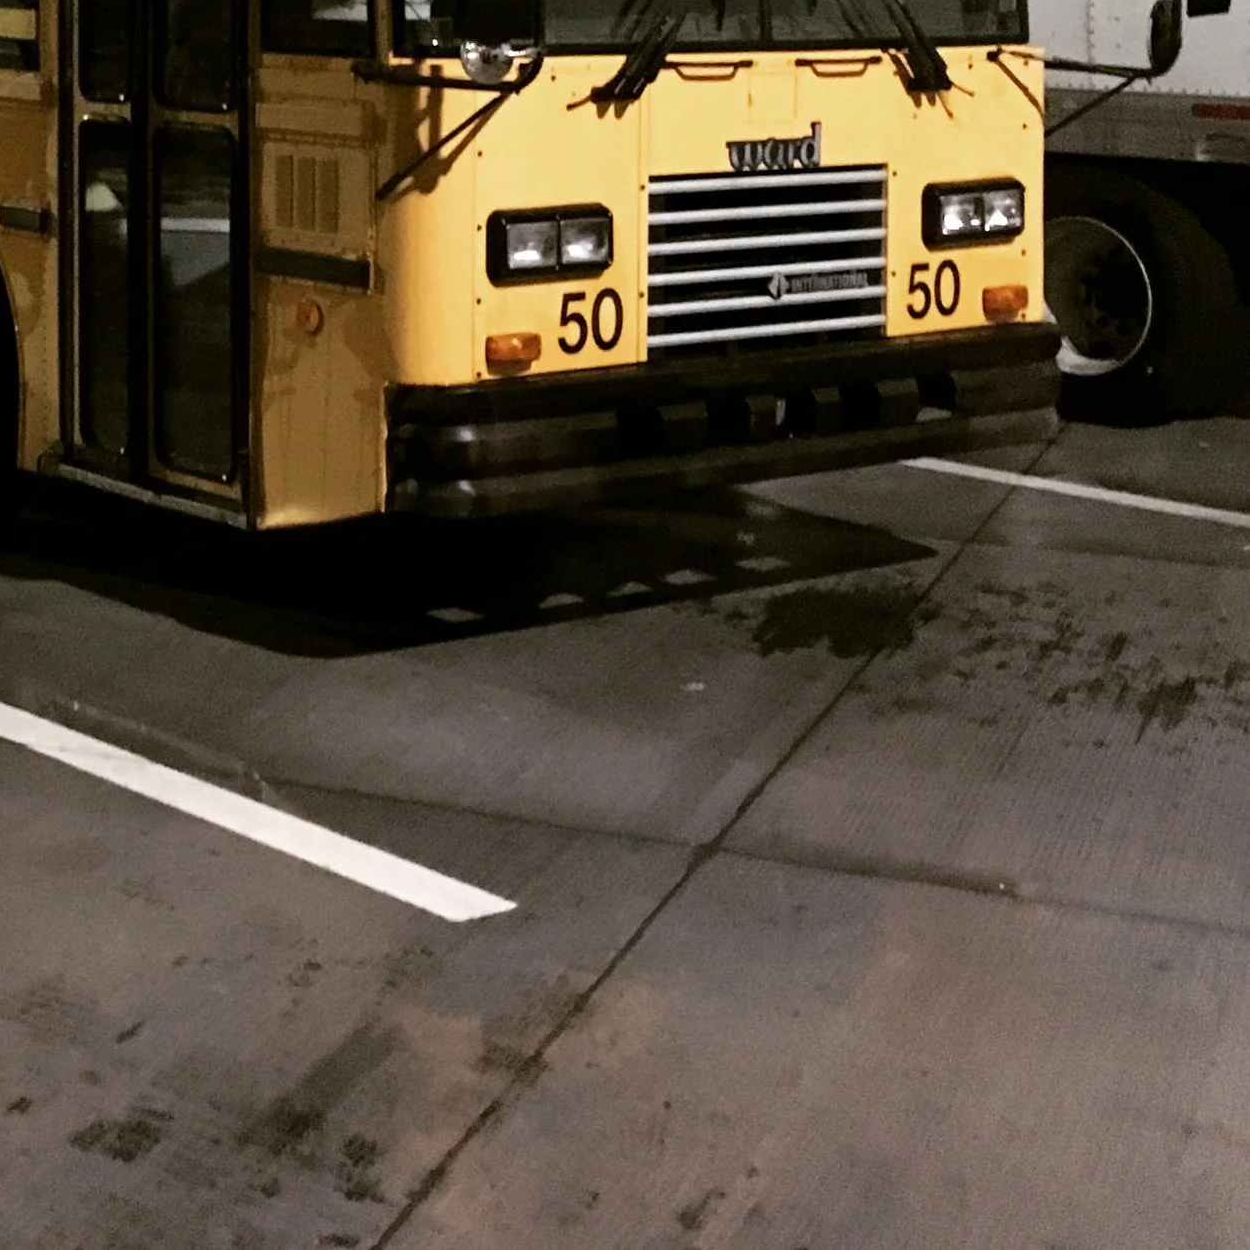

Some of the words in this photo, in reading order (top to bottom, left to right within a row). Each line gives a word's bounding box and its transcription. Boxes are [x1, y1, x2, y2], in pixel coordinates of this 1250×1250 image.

[726, 121, 822, 171] ward
[907, 259, 960, 319] 50
[558, 288, 623, 354] 50
